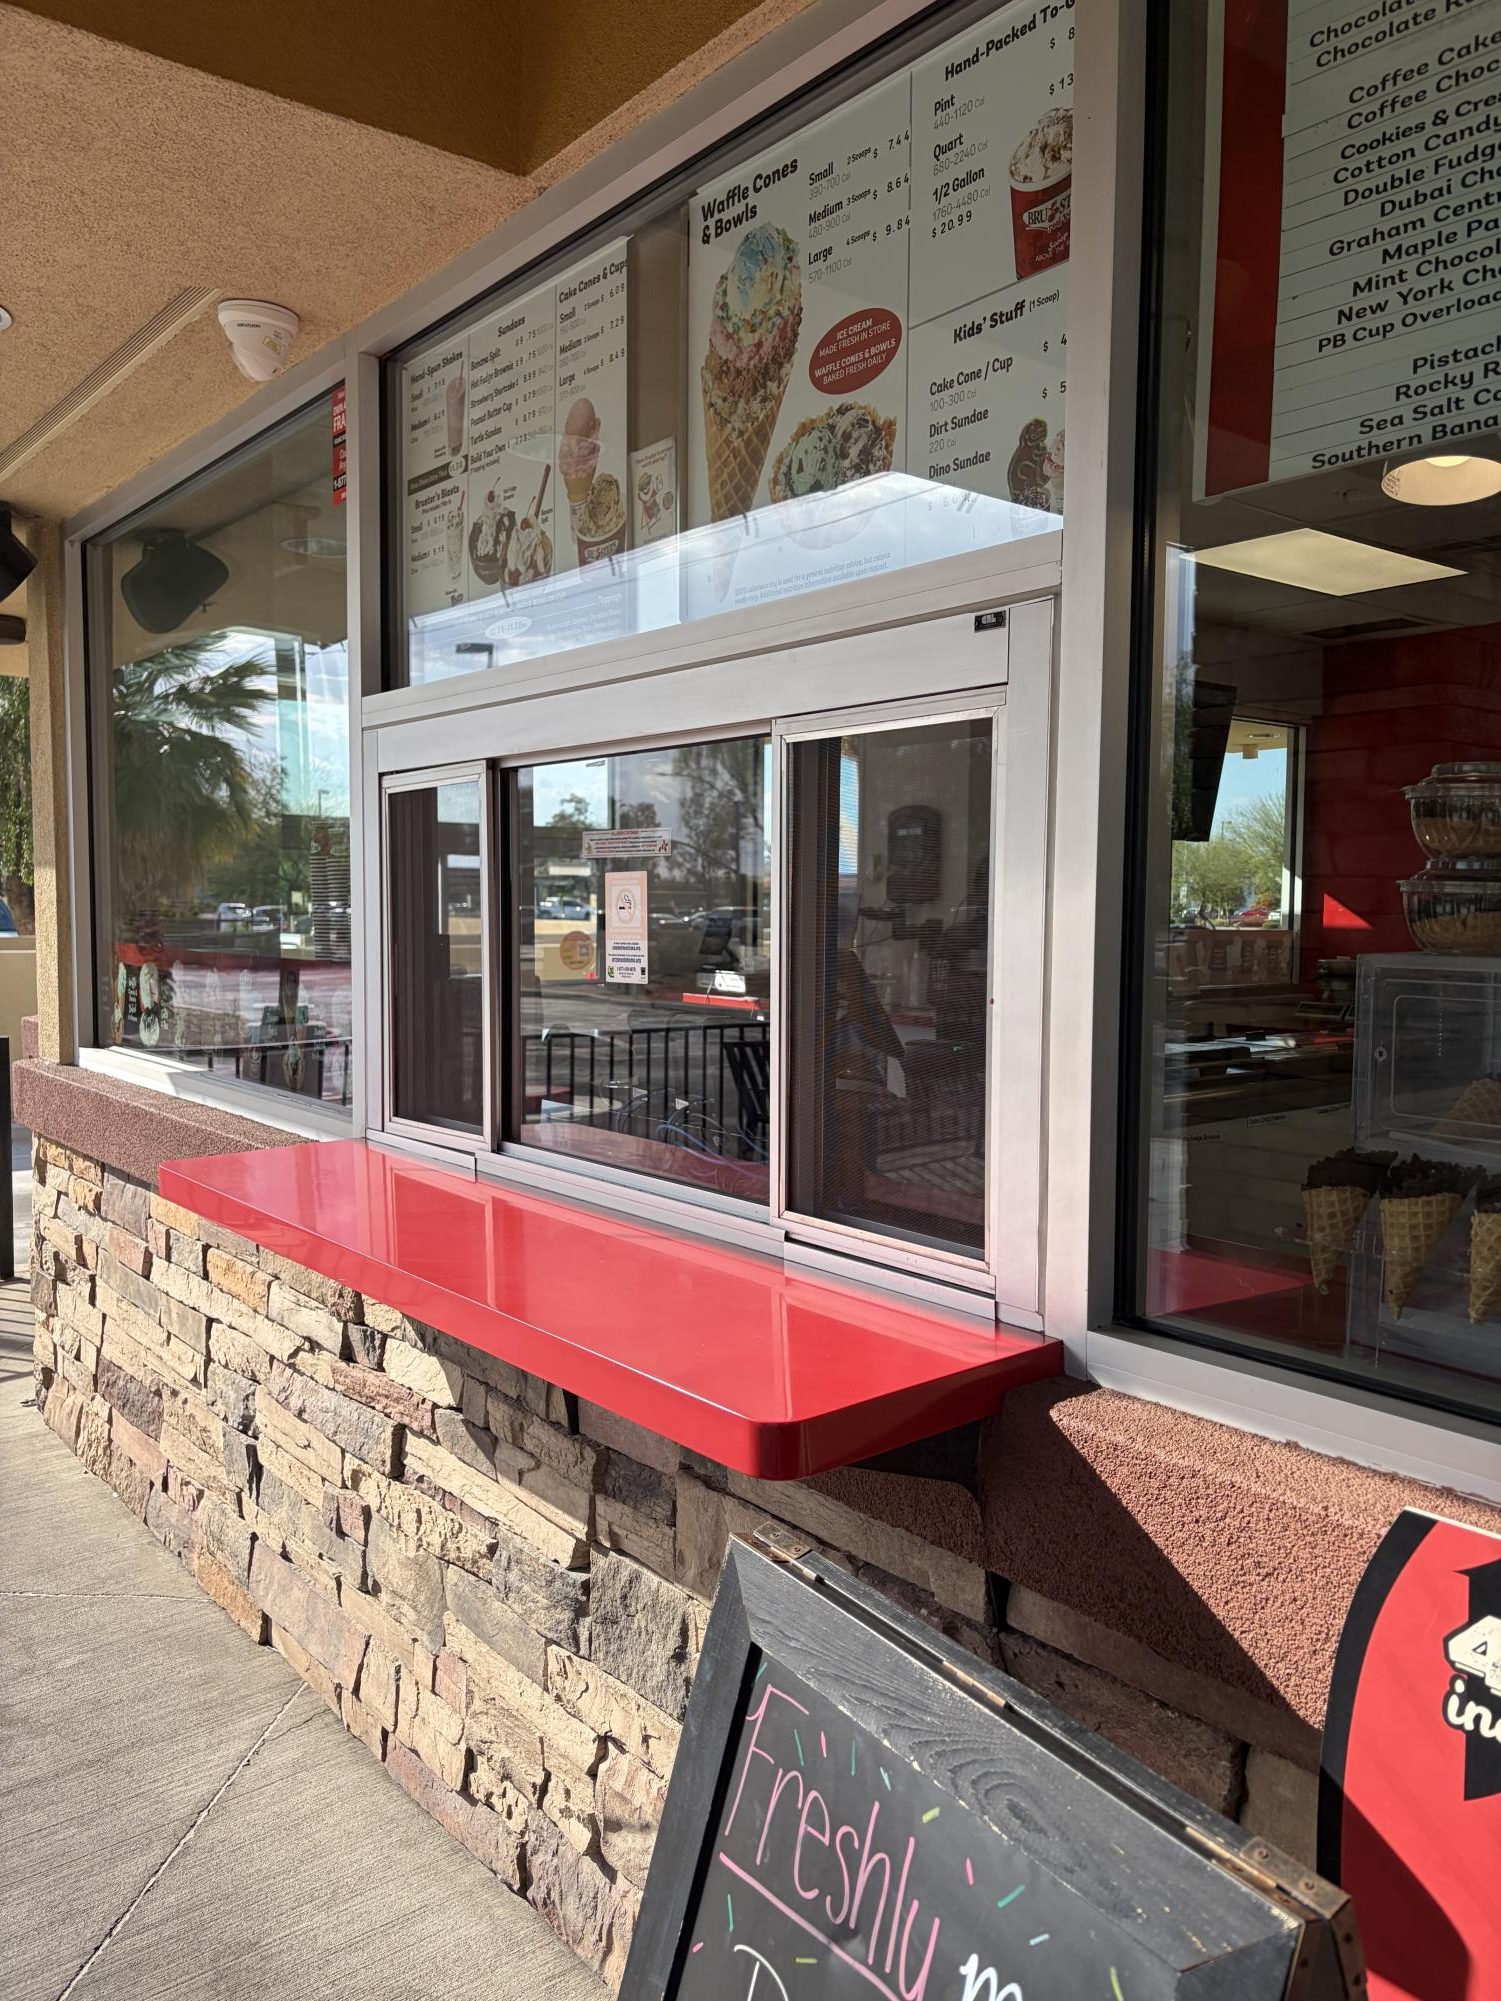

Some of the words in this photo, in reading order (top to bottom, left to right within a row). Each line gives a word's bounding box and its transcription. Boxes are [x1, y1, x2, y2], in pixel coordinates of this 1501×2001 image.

[945, 13, 1037, 81] Hand-Packed
[1316, 7, 1437, 68] Chocolate
[934, 94, 956, 117] Pint
[1050, 37, 1056, 50] $
[1349, 61, 1429, 104] Coffee
[1437, 30, 1501, 66] Cake
[1347, 88, 1428, 130] Coffee
[1435, 58, 1501, 94] Choc
[933, 100, 973, 130] 440-1120
[933, 133, 963, 162] Quart
[1049, 83, 1055, 96] $
[1340, 119, 1426, 160] Cookies
[1432, 108, 1449, 128] &
[809, 161, 834, 186] Small
[851, 146, 872, 162] Scoops
[873, 148, 878, 159] $
[933, 143, 976, 176] 880-2240
[1333, 147, 1416, 185] Cotton
[701, 184, 749, 222] Waffle
[753, 159, 798, 193] Cones
[932, 182, 950, 205] 1/2
[952, 167, 985, 192] Gallon
[1343, 166, 1425, 206] Double
[1380, 178, 1452, 217] Dubai
[701, 225, 711, 245] &
[714, 202, 757, 239] Bowls
[808, 200, 844, 226] Medium
[851, 188, 871, 204] Scoops
[873, 190, 877, 201] $
[932, 189, 978, 222] 1760-4480
[808, 245, 833, 266] Large
[850, 230, 871, 245] Scoops
[872, 231, 877, 242] $
[932, 227, 937, 238] $
[1329, 217, 1426, 257] Graham
[1382, 230, 1458, 264] Maple
[559, 287, 577, 303] Cake
[578, 274, 601, 293] Cones
[602, 267, 608, 279] &
[1337, 299, 1389, 325] New
[1397, 277, 1454, 306] York
[1352, 267, 1408, 298] Mint
[560, 306, 576, 324] Small
[989, 299, 1026, 330] Stuff
[1037, 289, 1060, 309] Scoop)
[559, 338, 582, 355] Medium
[820, 342, 838, 358] MADE
[838, 335, 860, 350] FRESH
[860, 330, 868, 340] IN
[869, 321, 891, 337] STORE
[836, 328, 848, 340] ICE
[848, 318, 873, 335] CREAM
[1318, 332, 1346, 353] PB
[1352, 321, 1395, 342] Cup
[442, 351, 463, 368] Shakes
[480, 372, 493, 385] Fudge
[494, 361, 514, 378] Brownie
[814, 361, 841, 378] WAFFLE
[841, 351, 864, 367] CONES
[870, 338, 896, 355] BOWLS
[823, 370, 845, 385] BAKED
[845, 362, 867, 376] FRESH
[867, 352, 887, 368] DAILY
[929, 377, 955, 396] Cake
[957, 366, 982, 386] Cone
[984, 361, 990, 381] /
[992, 355, 1013, 375] Cup
[1043, 341, 1049, 353] $
[559, 373, 575, 387] Large
[1395, 370, 1475, 402] Rocky
[487, 407, 502, 420] Butter
[502, 402, 512, 413] Cup
[929, 390, 965, 413] 100-300
[929, 420, 949, 438] Dirt
[950, 407, 989, 431] Sundae
[1042, 387, 1048, 400] $
[1359, 413, 1404, 435] Sea
[1412, 396, 1466, 422] Salt
[495, 444, 506, 454] Own
[929, 439, 945, 453] 220
[1311, 431, 1423, 470] Southern
[1431, 415, 1499, 442] Bana
[929, 462, 950, 480] Dino
[952, 449, 991, 473] Sundae
[415, 491, 440, 510] Bruster's
[441, 485, 459, 500] Blasts
[725, 1684, 942, 2001] Freshly
